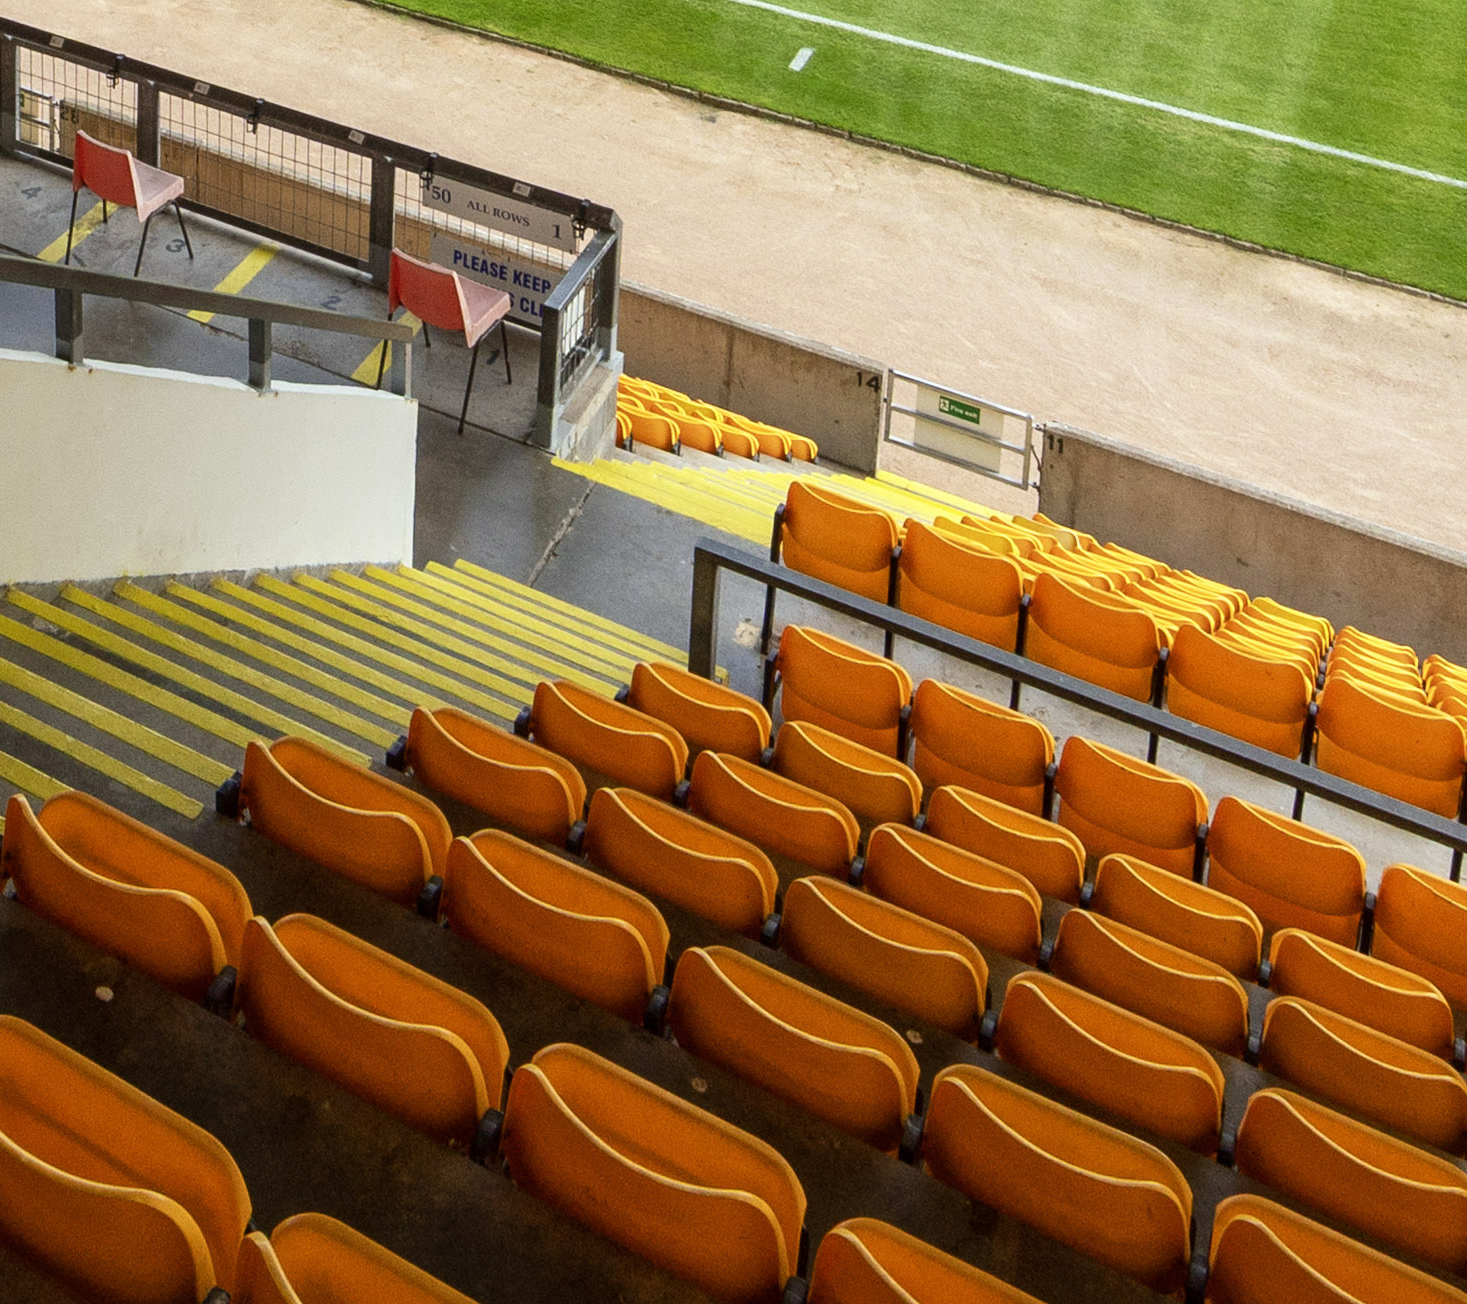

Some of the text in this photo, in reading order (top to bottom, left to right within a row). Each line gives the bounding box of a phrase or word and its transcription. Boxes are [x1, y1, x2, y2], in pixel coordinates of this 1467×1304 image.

[431, 186, 562, 240] 50 ALL ROWS 1
[166, 239, 185, 253] 3
[453, 249, 552, 295] PLEASE KEEP
[321, 294, 342, 311] 2
[856, 371, 881, 393] 14
[1047, 434, 1064, 454] 11
